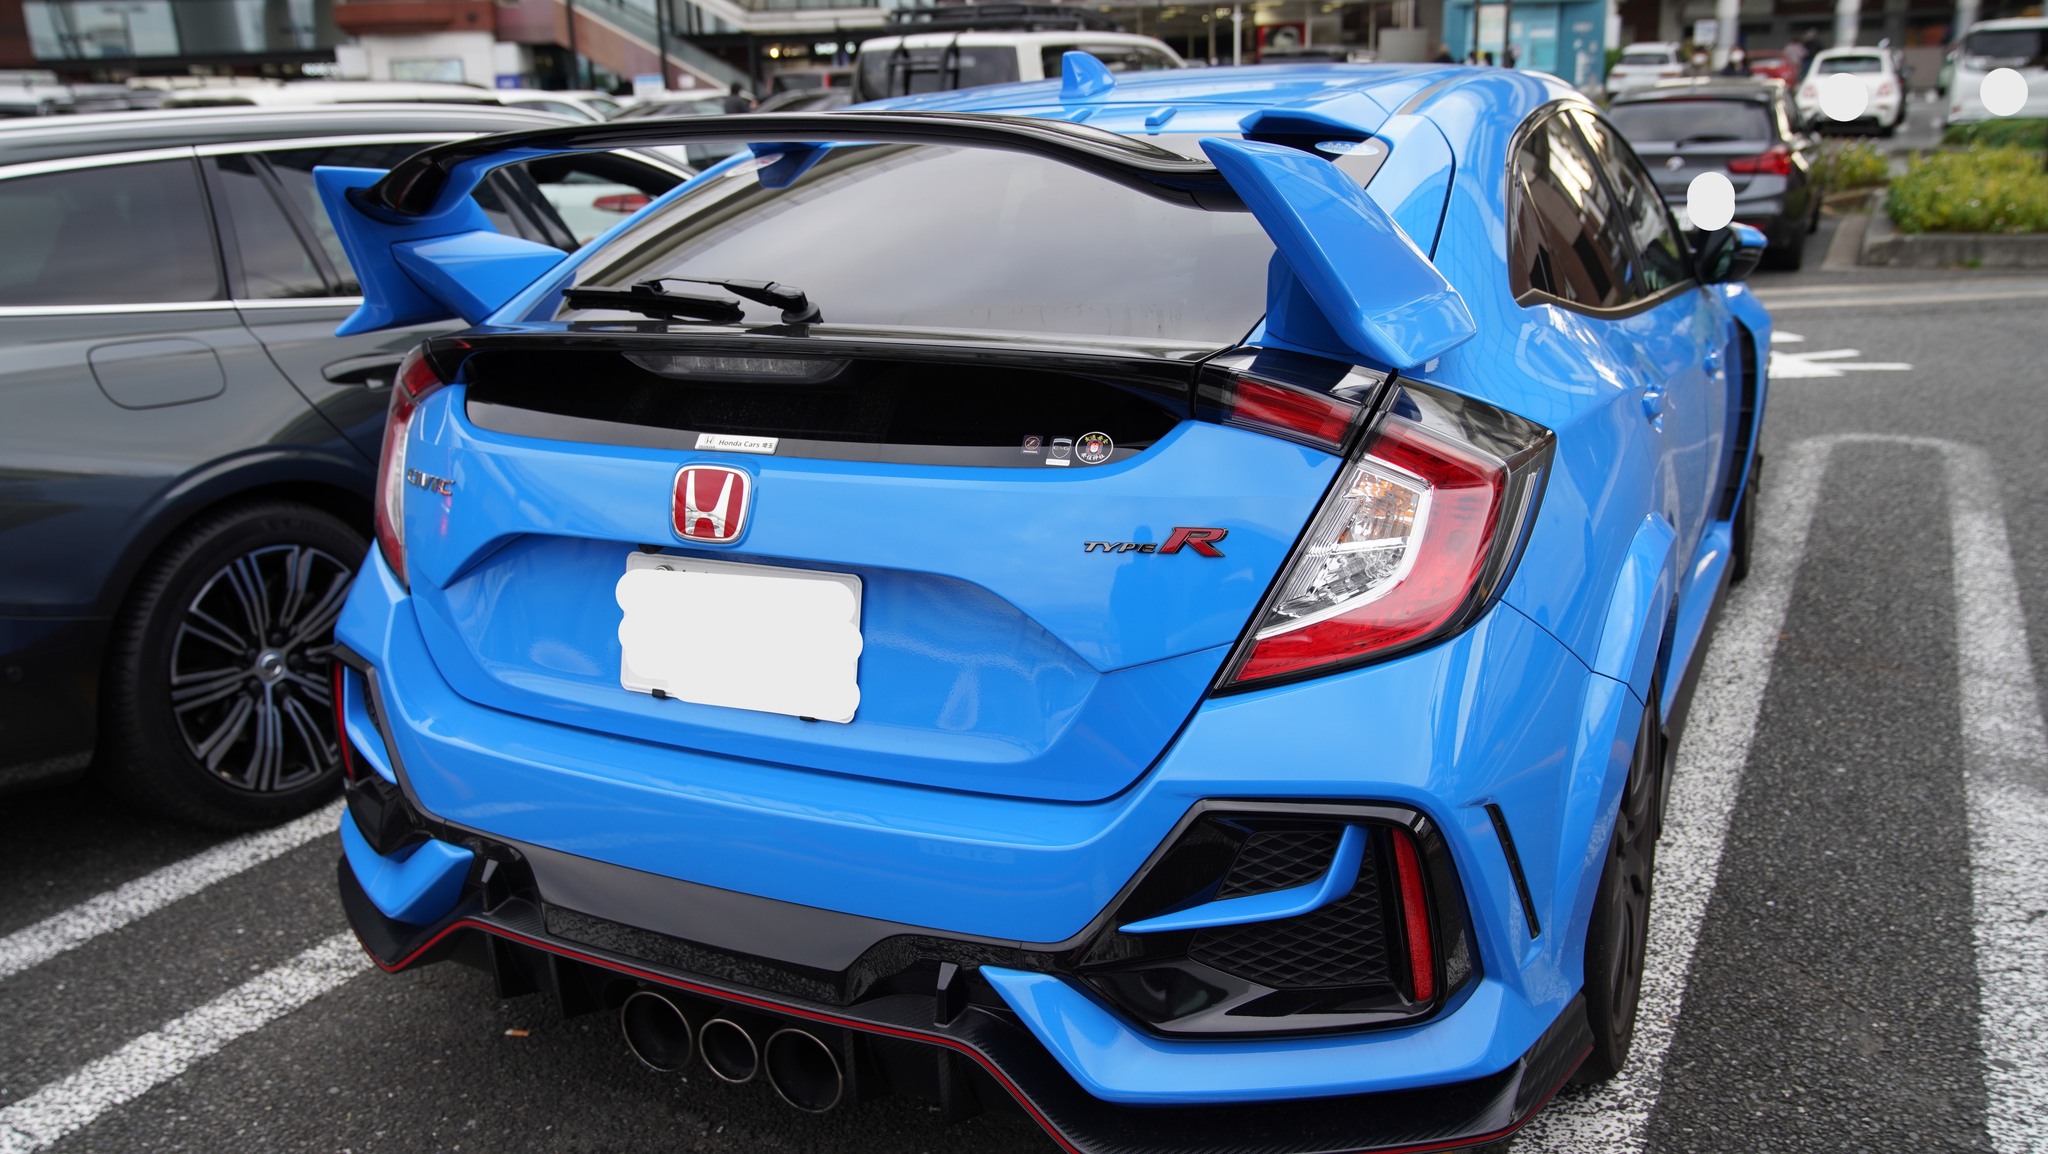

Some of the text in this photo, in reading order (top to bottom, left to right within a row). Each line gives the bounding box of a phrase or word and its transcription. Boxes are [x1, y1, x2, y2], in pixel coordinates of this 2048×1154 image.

[407, 468, 456, 496] CIVIC
[1084, 527, 1229, 558] TYPE R
